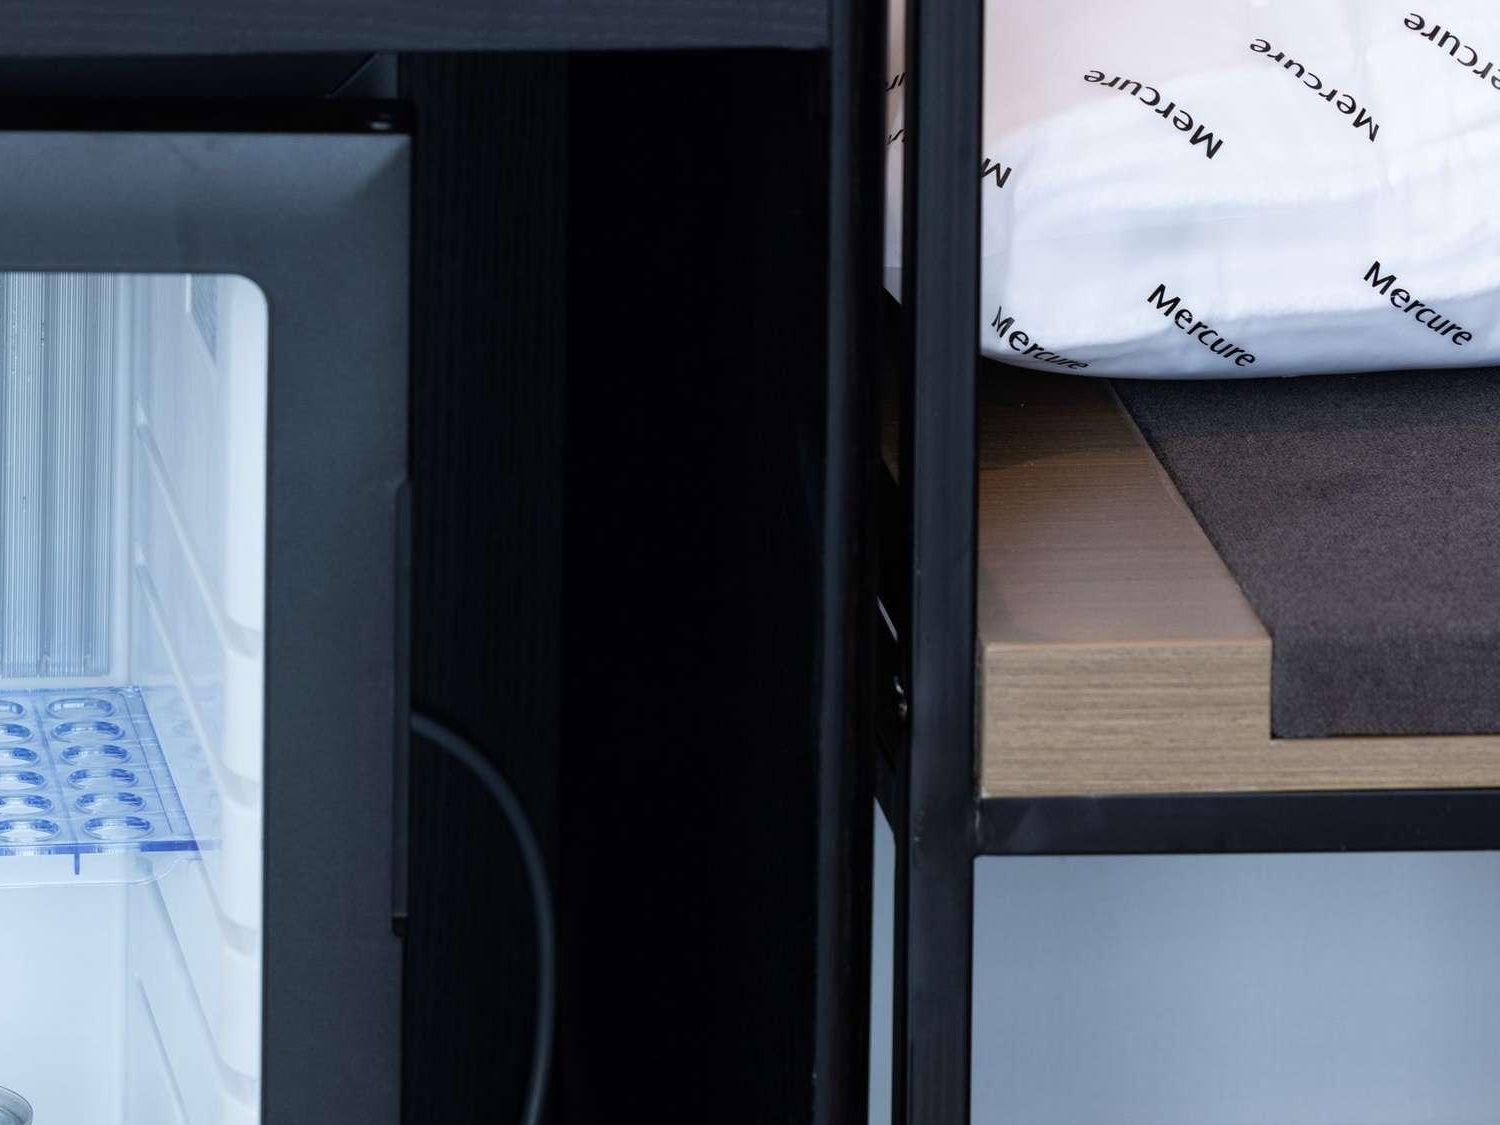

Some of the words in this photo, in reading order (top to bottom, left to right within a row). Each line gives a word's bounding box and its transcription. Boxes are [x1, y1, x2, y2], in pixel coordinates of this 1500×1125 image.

[1249, 38, 1380, 142] Mercure
[1403, 12, 1500, 90] rcure
[1083, 69, 1224, 160] Mercure
[991, 304, 1090, 370] Mercure
[1147, 283, 1257, 367] Mercure
[1364, 260, 1473, 347] Mercure
